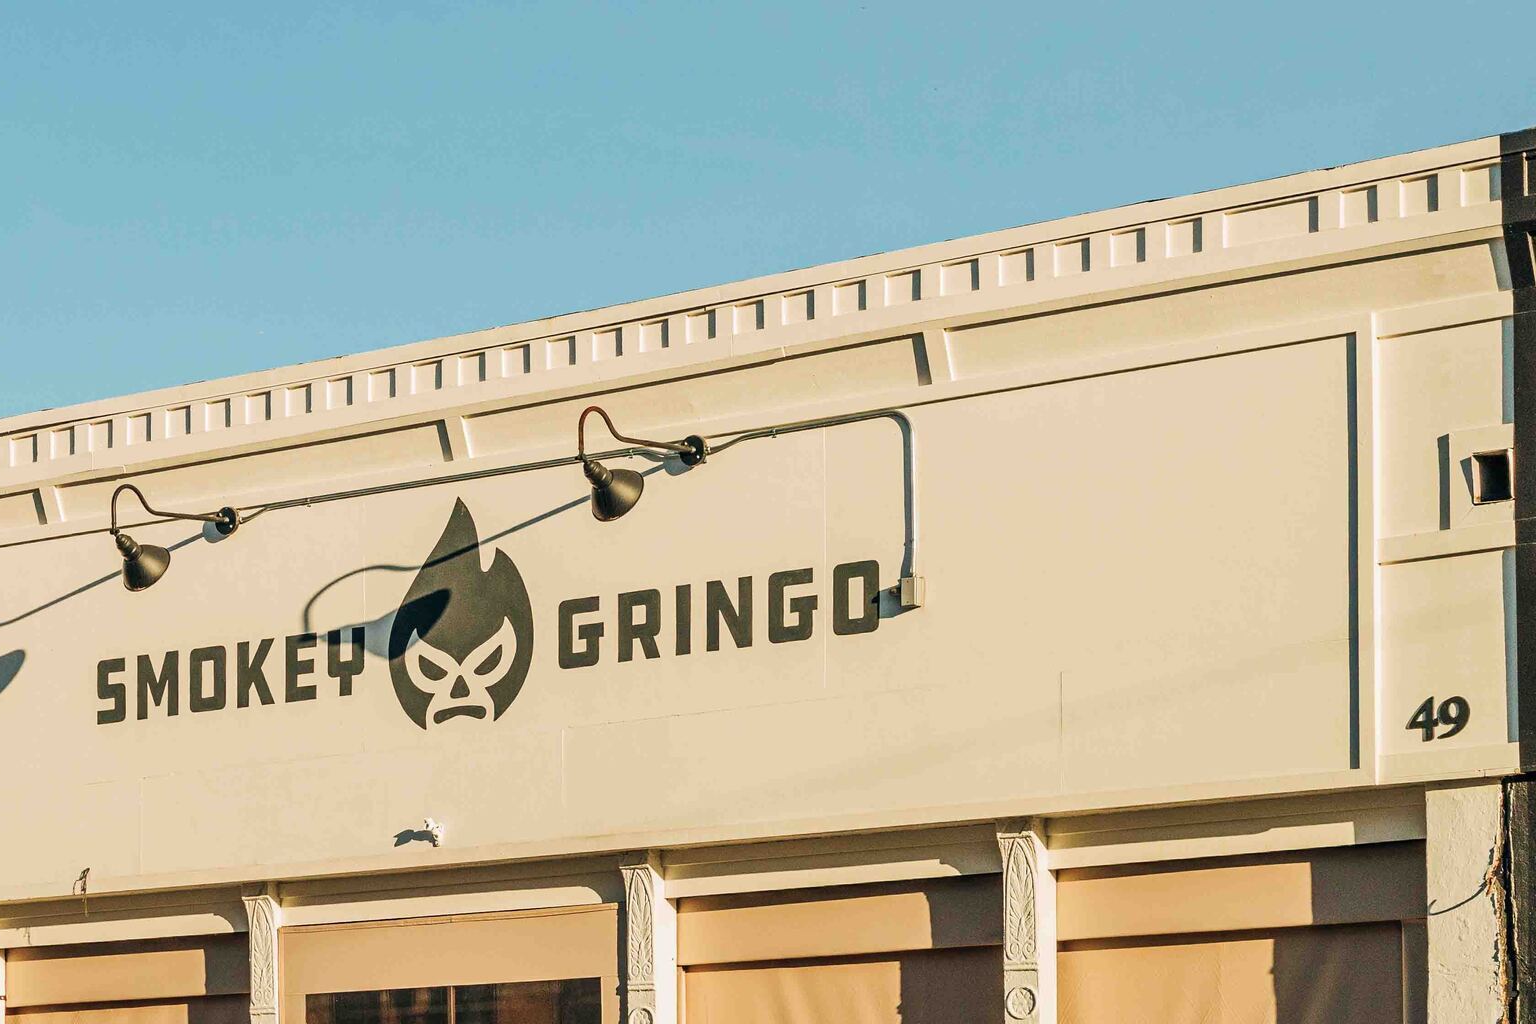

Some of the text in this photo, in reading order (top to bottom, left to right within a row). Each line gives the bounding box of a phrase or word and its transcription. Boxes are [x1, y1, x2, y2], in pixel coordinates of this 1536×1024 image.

[96, 559, 880, 725] SMOKEY GRINGO
[1404, 695, 1471, 742] 49
